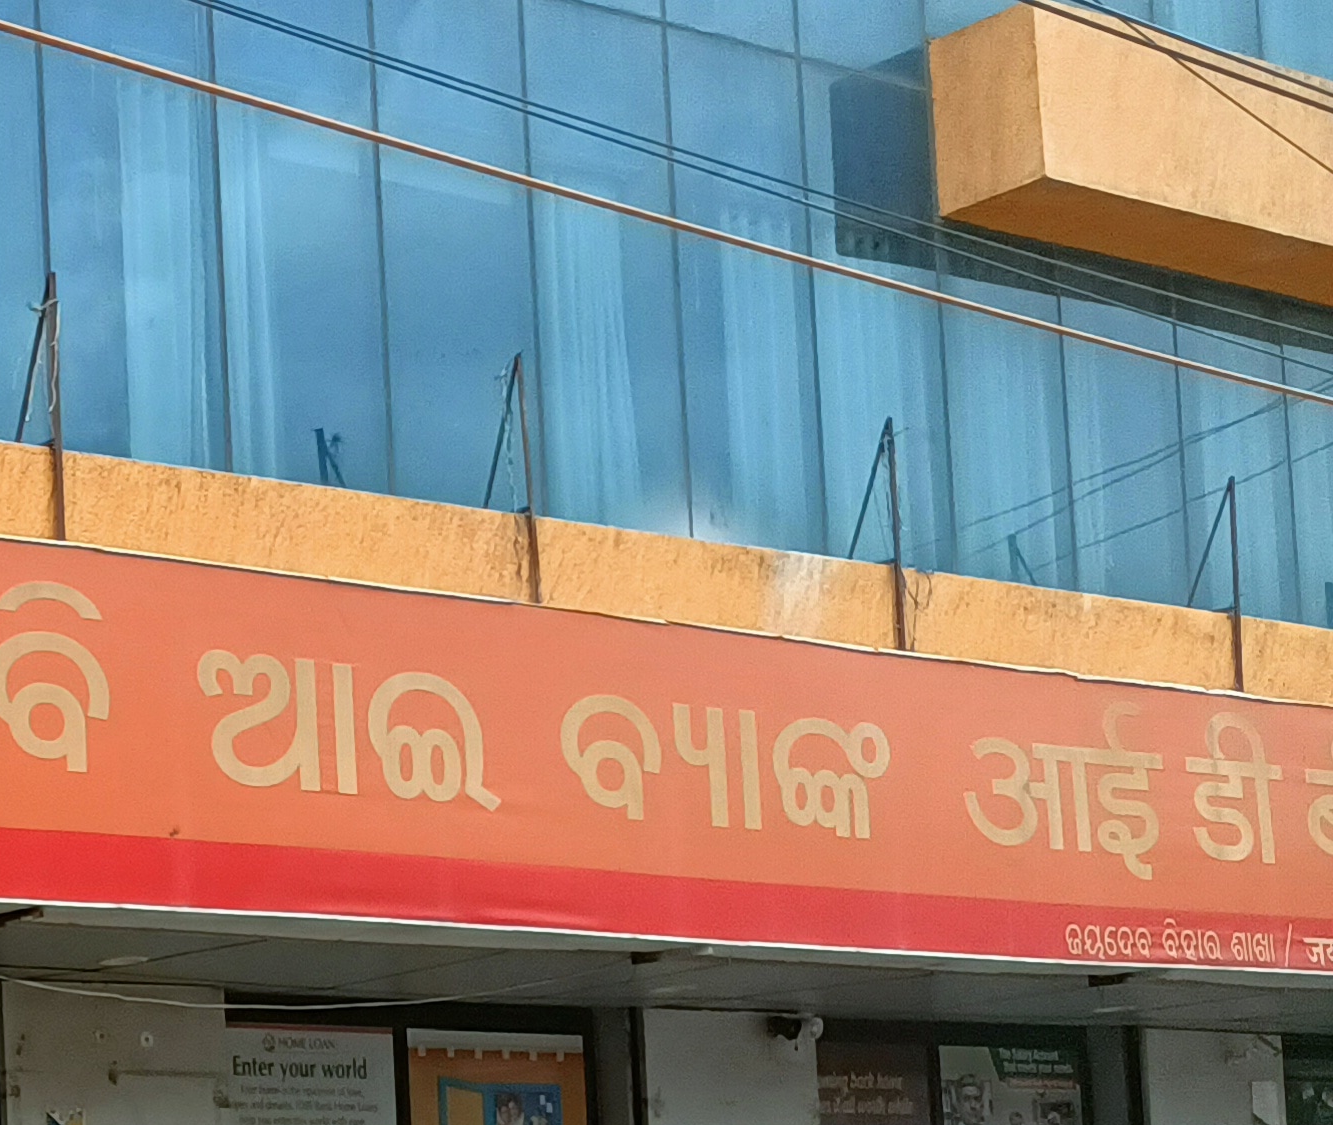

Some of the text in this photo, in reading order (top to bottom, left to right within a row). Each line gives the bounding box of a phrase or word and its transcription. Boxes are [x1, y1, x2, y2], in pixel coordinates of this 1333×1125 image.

[197, 649, 501, 812] ଆଇ
[964, 701, 1165, 880] आई
[1185, 711, 1283, 864] डी
[232, 1054, 368, 1082] Enter your world
